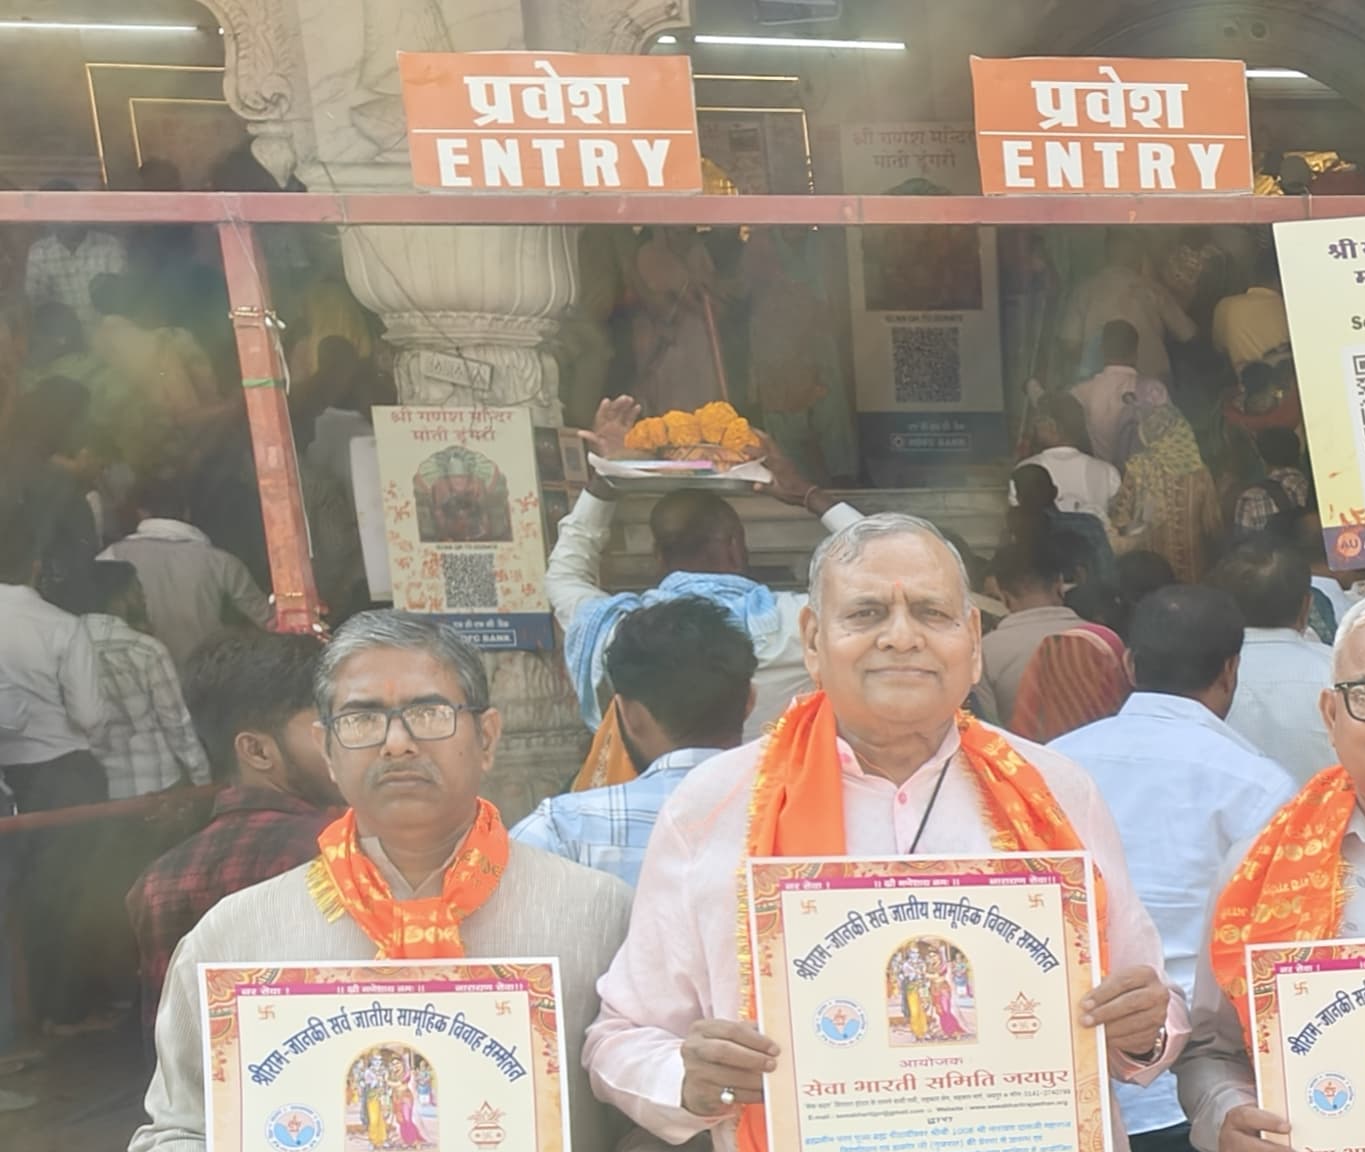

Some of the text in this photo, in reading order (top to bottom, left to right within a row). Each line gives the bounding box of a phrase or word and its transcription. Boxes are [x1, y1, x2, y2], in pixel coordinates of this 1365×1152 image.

[463, 60, 630, 127] प्रवेश
[1031, 66, 1188, 130] प्रवेश
[436, 138, 671, 187] ENTRY
[1002, 140, 1225, 190] ENTRY
[1328, 239, 1358, 260] श्री
[866, 900, 889, 928] सर्व
[889, 895, 929, 921] जातीय
[932, 896, 985, 928] सामूहिक
[983, 905, 1021, 940] विवाह
[1016, 930, 1059, 973] सम्मेलन
[327, 1006, 351, 1034] सर्व
[351, 1001, 393, 1028] जातीय
[397, 1003, 450, 1036] सामूहिक
[448, 1012, 488, 1048] विवाह
[482, 1038, 526, 1082] सम्मेलन
[805, 1070, 1068, 1096] सेवा भारती समिति जयपुर
